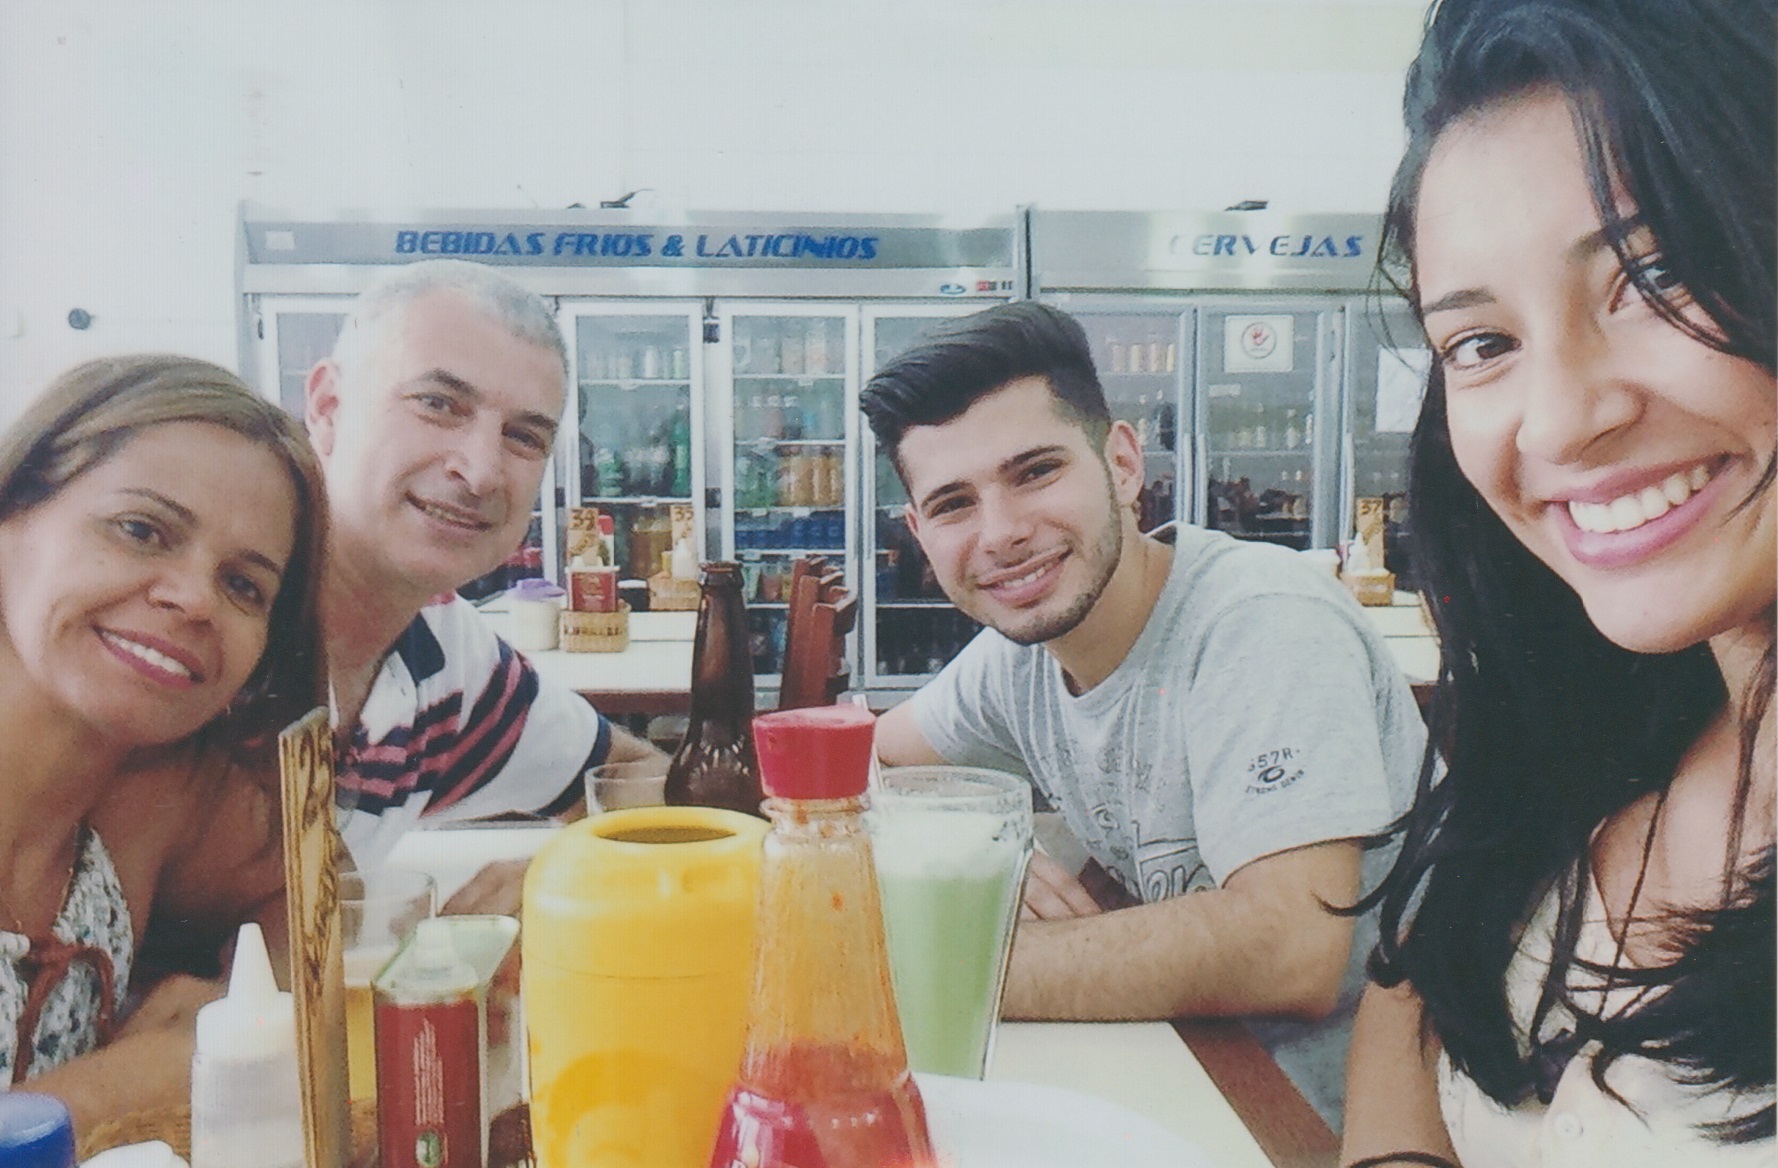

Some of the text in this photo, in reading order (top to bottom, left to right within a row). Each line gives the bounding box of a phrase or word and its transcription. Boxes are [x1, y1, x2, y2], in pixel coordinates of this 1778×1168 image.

[395, 230, 546, 255] BEBIDAS
[552, 232, 654, 257] FRIOS
[660, 234, 685, 257] &
